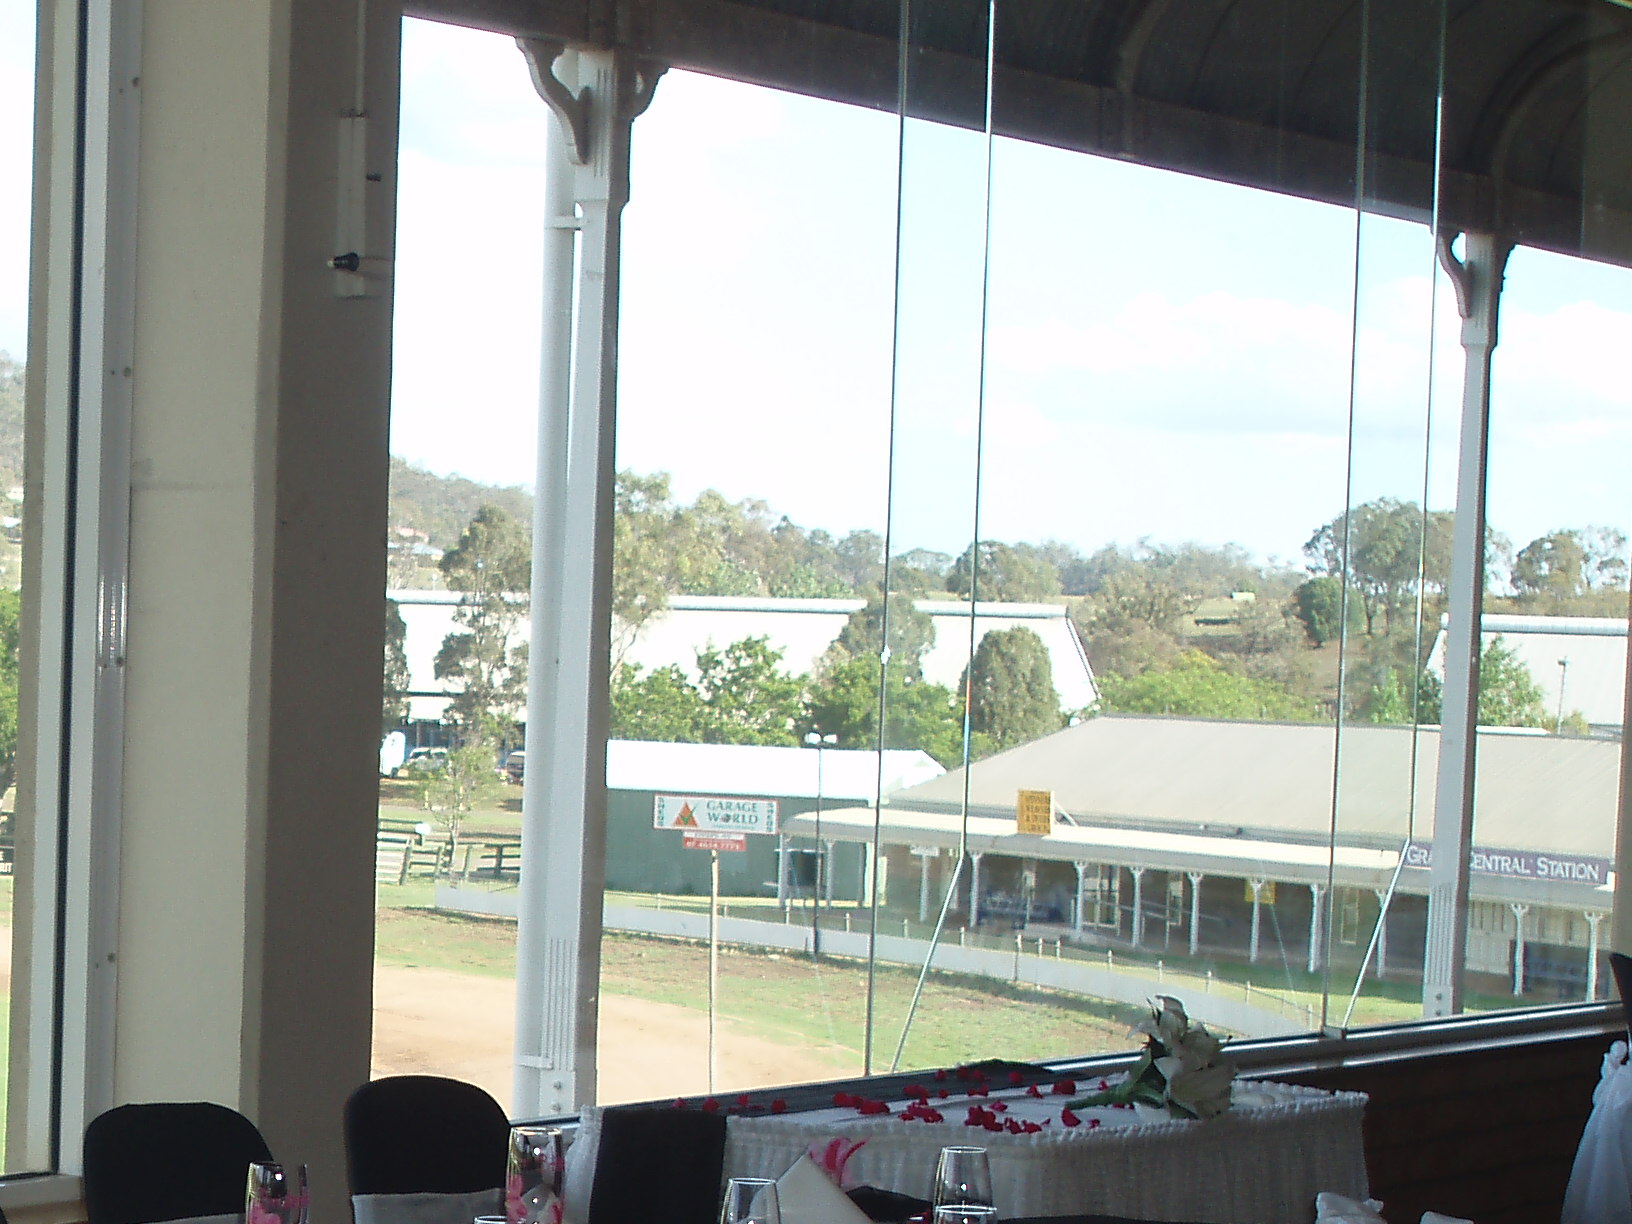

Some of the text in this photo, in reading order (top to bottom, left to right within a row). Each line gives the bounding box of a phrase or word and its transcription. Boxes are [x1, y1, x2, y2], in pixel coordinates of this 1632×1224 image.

[707, 801, 758, 812] GARAGE
[708, 812, 758, 824] WORLD
[1471, 853, 1531, 874] ENTRAL
[1536, 857, 1599, 880] STATION
